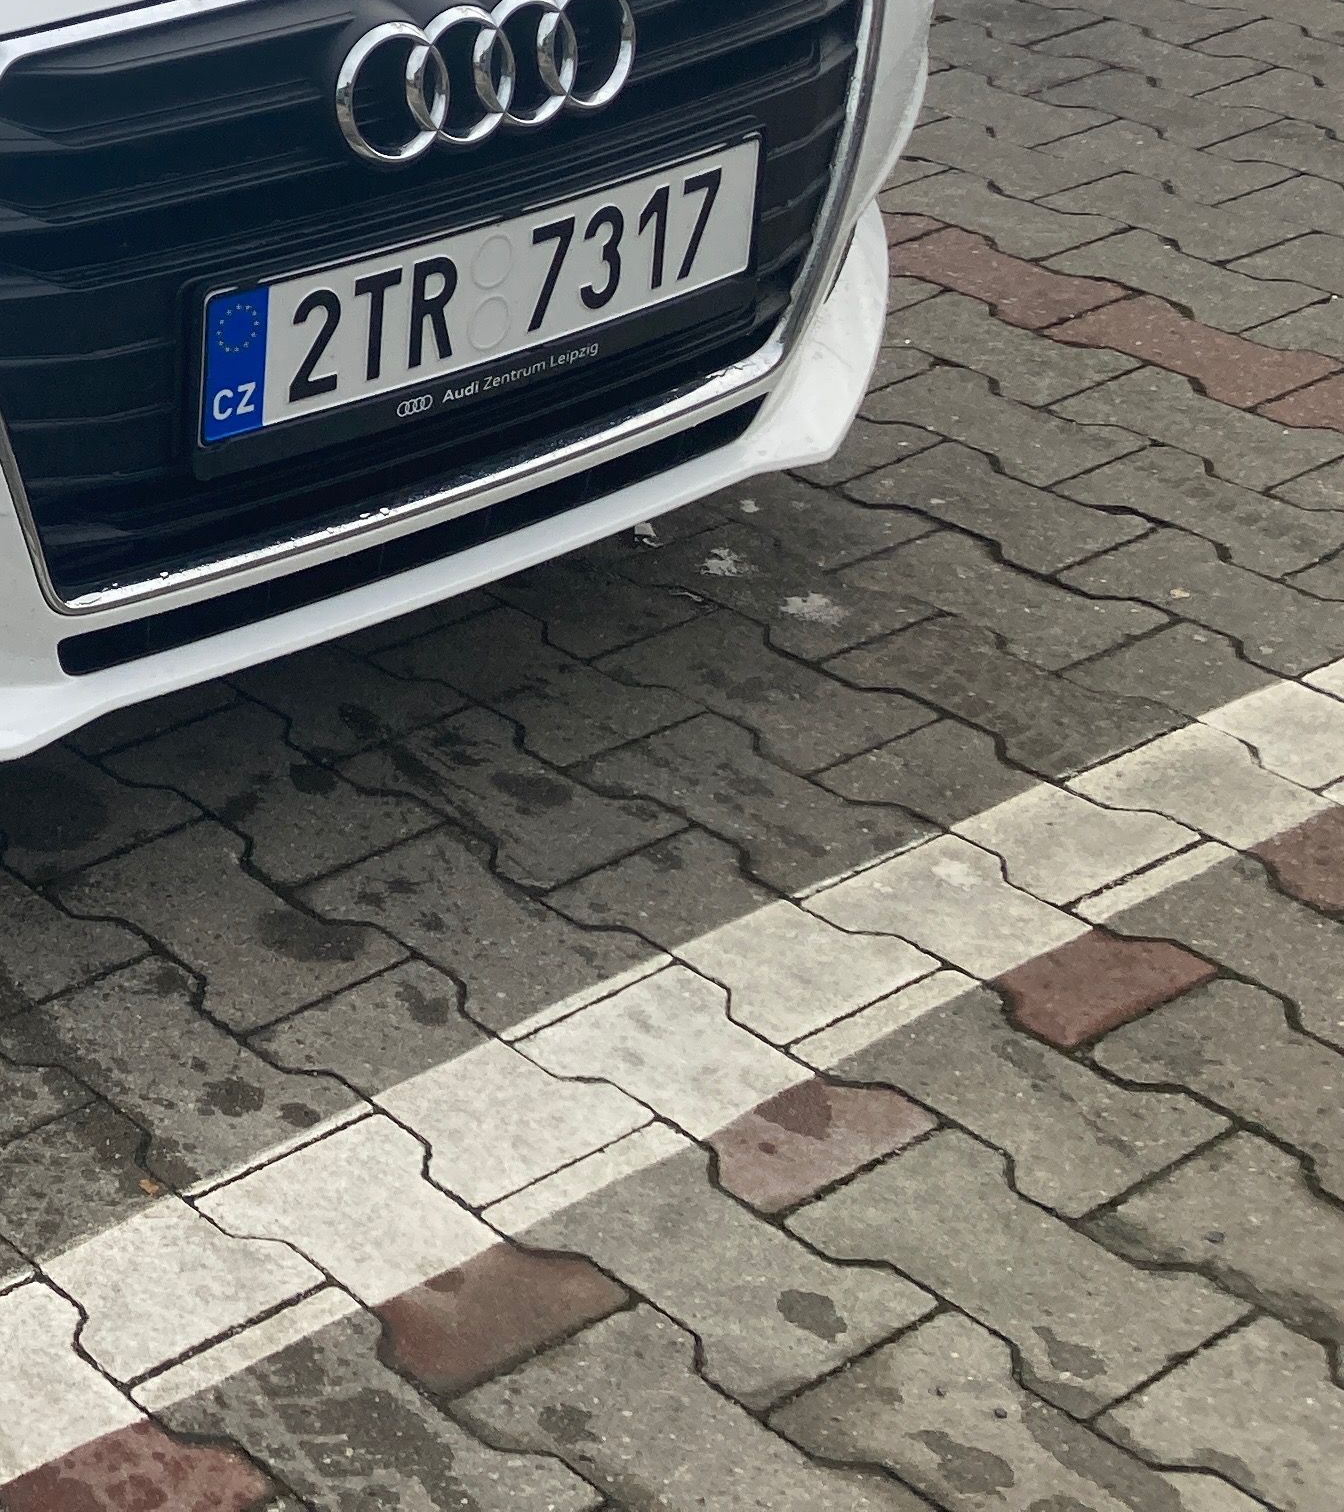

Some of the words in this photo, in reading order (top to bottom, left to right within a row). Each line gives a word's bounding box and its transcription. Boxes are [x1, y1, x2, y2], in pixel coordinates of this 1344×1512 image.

[288, 256, 458, 403] 2TR
[526, 167, 723, 333] 7317
[212, 381, 256, 422] CZ
[442, 380, 480, 404] Audi
[483, 360, 547, 391] Zentrum
[549, 342, 600, 368] Leipzig
